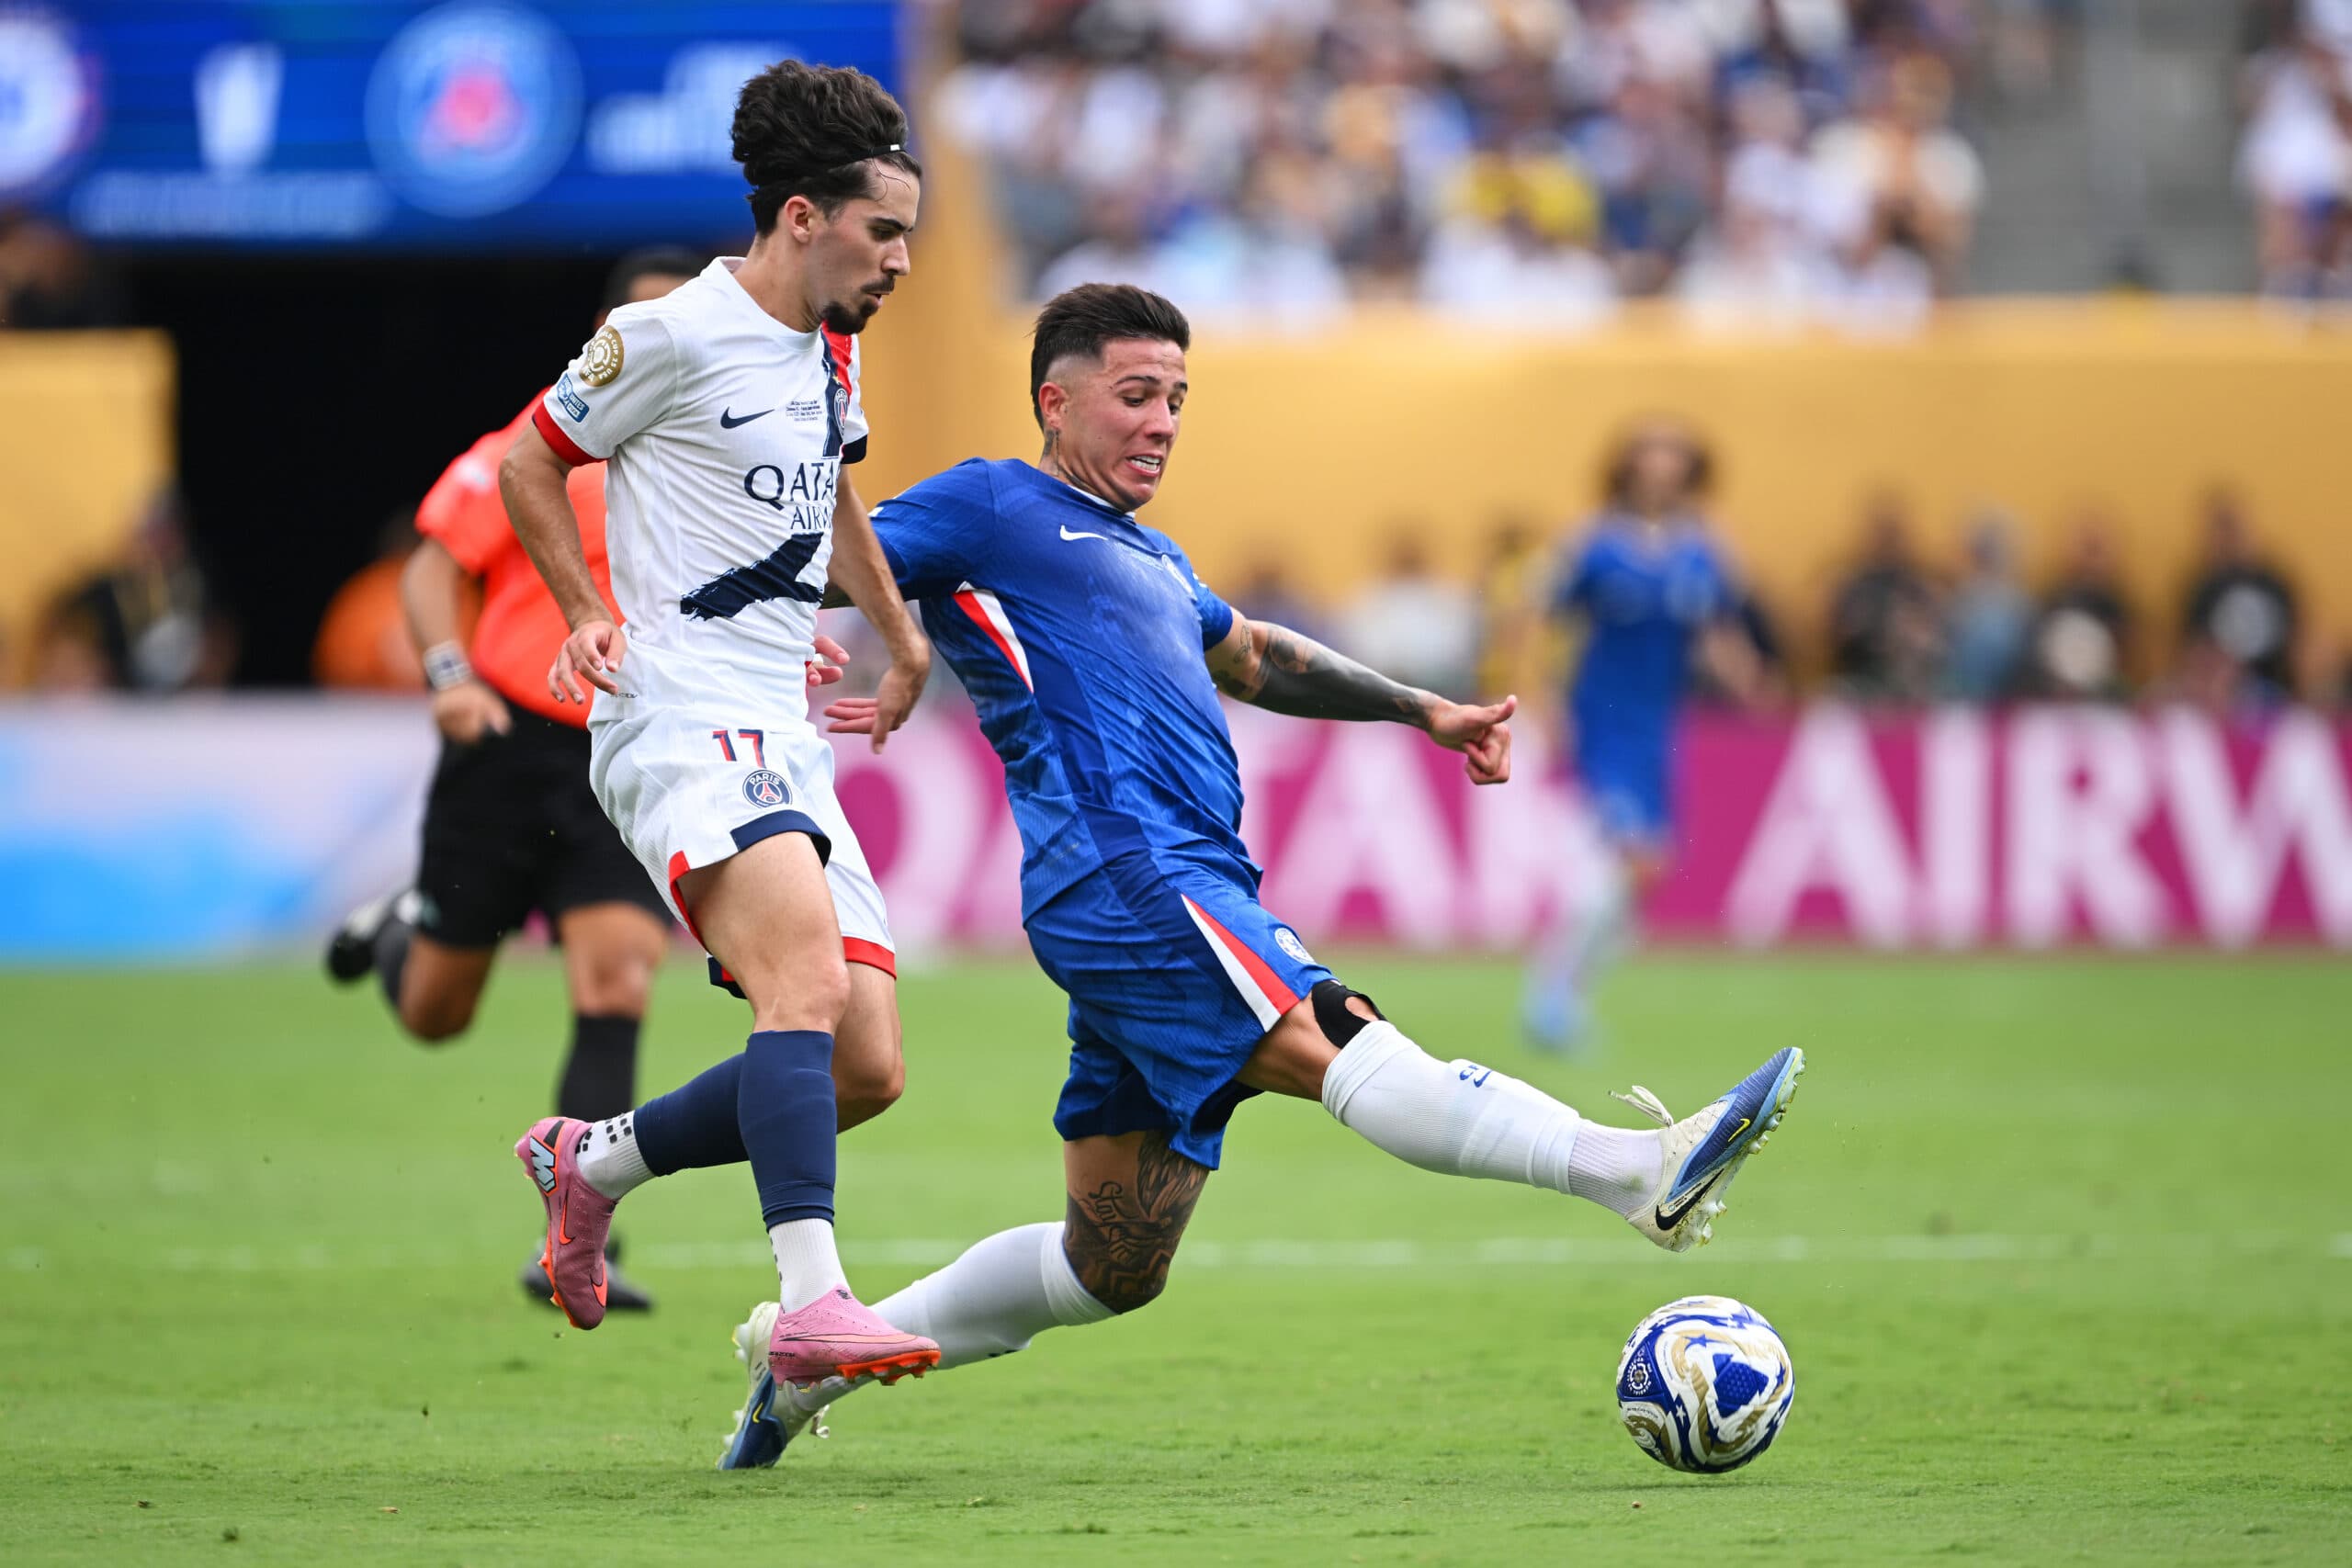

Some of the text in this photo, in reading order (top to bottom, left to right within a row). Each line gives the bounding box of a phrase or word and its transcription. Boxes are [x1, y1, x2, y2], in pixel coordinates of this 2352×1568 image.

[610, 339, 619, 355] CUP
[743, 461, 838, 512] QATA
[712, 728, 766, 769] 17
[749, 773, 781, 786] PARIS
